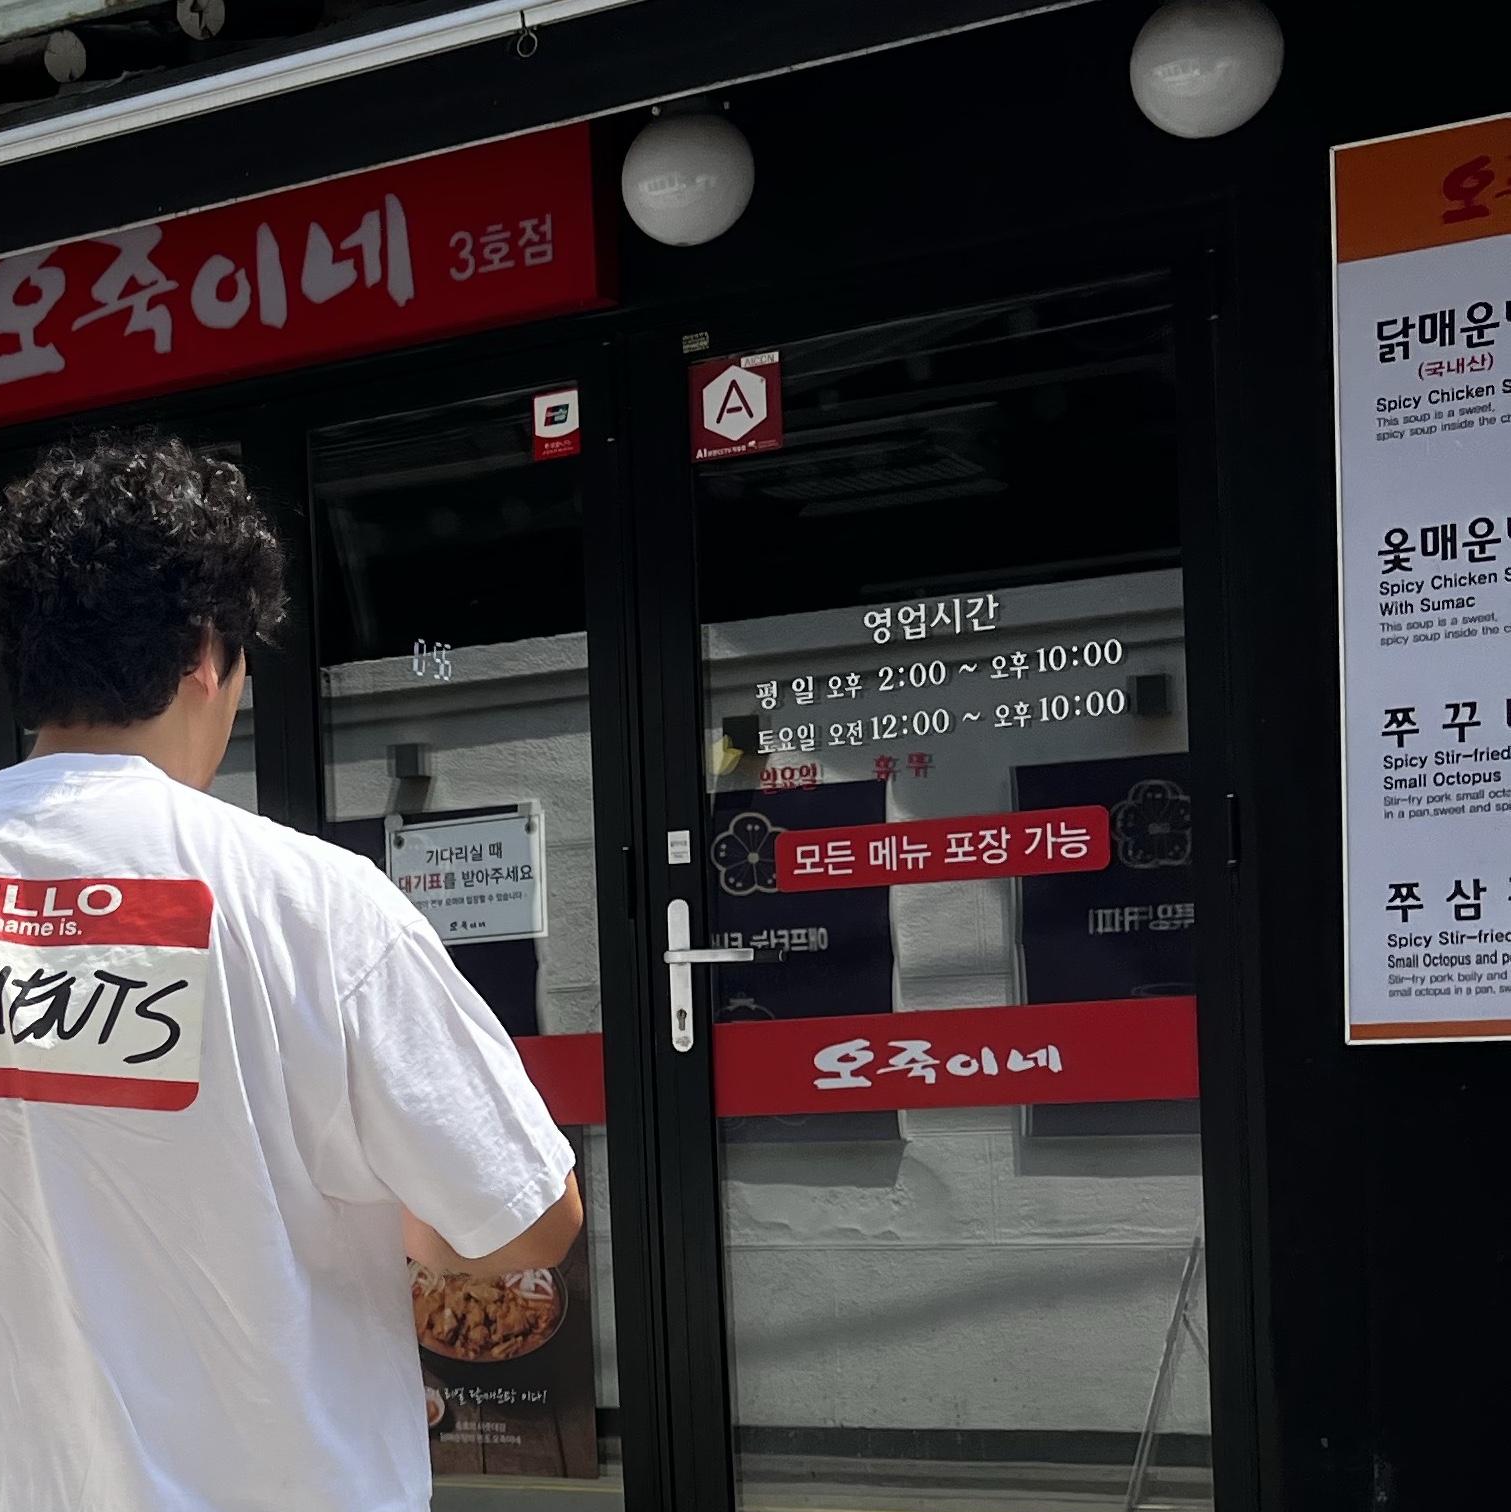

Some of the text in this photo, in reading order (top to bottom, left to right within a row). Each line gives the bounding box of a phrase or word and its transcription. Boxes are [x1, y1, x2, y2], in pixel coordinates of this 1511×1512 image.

[449, 212, 553, 281] 3호점
[1377, 301, 1511, 363] 닭매운
[1418, 353, 1494, 380] (국내산)
[1376, 395, 1422, 413] Spicy
[1428, 383, 1495, 405] Chicken
[1376, 430, 1405, 442] spicy
[1409, 425, 1437, 436] soup
[1441, 419, 1475, 432] inside
[1478, 415, 1497, 427] the
[1403, 413, 1431, 425] soup
[1447, 409, 1455, 418] a
[1377, 517, 1511, 575] 옻매운
[1379, 579, 1425, 597] Spicy
[1431, 572, 1498, 590] Chicken
[1379, 596, 1476, 617] With Sumac
[864, 594, 1000, 644] 영업시간
[1406, 620, 1434, 631] soup
[1450, 617, 1458, 626] a
[1380, 636, 1409, 647] spicy
[1412, 632, 1441, 643] soup
[1444, 628, 1478, 639] inside
[1482, 626, 1500, 636] the
[826, 672, 863, 699] 오후
[878, 660, 946, 692] 2:00
[990, 651, 1030, 680] 오후
[1035, 638, 1123, 673] 10:00
[757, 723, 816, 754] 토요일
[828, 720, 863, 746] 오전
[870, 708, 950, 740] 12:00
[994, 701, 1032, 728] 오후
[1039, 688, 1126, 722] 10:00
[1383, 754, 1429, 771] Spicy
[759, 763, 818, 795] 일요일
[1383, 770, 1502, 790] Small Octopus
[1455, 789, 1485, 801] small
[1384, 809, 1393, 819] in
[1398, 810, 1405, 818] a
[1469, 802, 1491, 814] and
[426, 842, 503, 866] 기다리실 때
[793, 821, 1091, 875] 모든 메뉴 포장 가능
[398, 864, 534, 893] 대기표를 받아주세요
[59, 914, 83, 937] is.
[1387, 932, 1433, 949] Spicy
[1387, 954, 1419, 969] Small
[1422, 952, 1472, 968] Octopus
[1475, 950, 1498, 965] and
[1486, 970, 1508, 981] and
[1414, 986, 1451, 997] octopus
[1454, 986, 1463, 995] in
[813, 1038, 1063, 1090] 오죽이네
